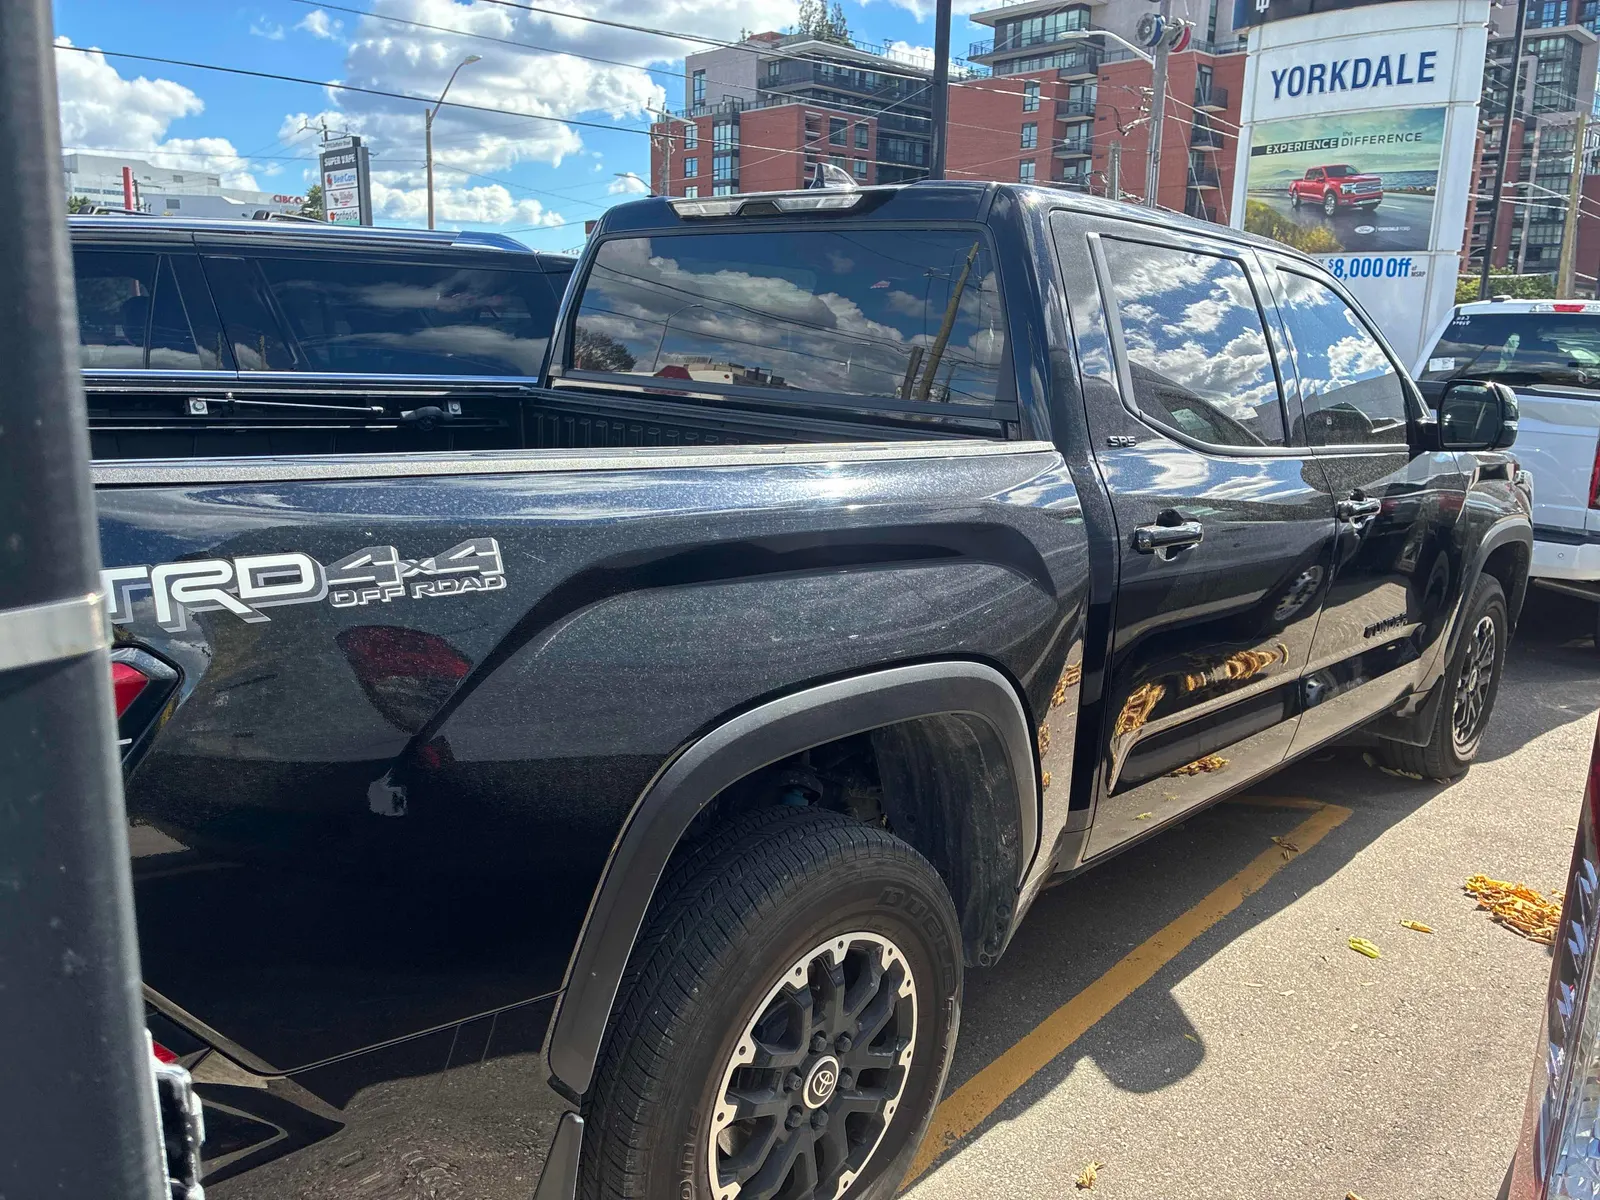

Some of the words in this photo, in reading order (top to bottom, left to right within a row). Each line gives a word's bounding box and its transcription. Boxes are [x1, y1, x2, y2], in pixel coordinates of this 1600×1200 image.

[1271, 51, 1437, 100] YORKDALE
[1266, 138, 1338, 154] EXPERIENCE
[1341, 132, 1422, 147] DIFFERENCE
[324, 156, 341, 166] SUPER
[341, 153, 356, 164] VAPE
[1328, 258, 1384, 281] $8,000
[1386, 257, 1412, 278] Off
[100, 553, 328, 632] TRD
[329, 585, 406, 608] OFF
[410, 575, 507, 600] ROAD
